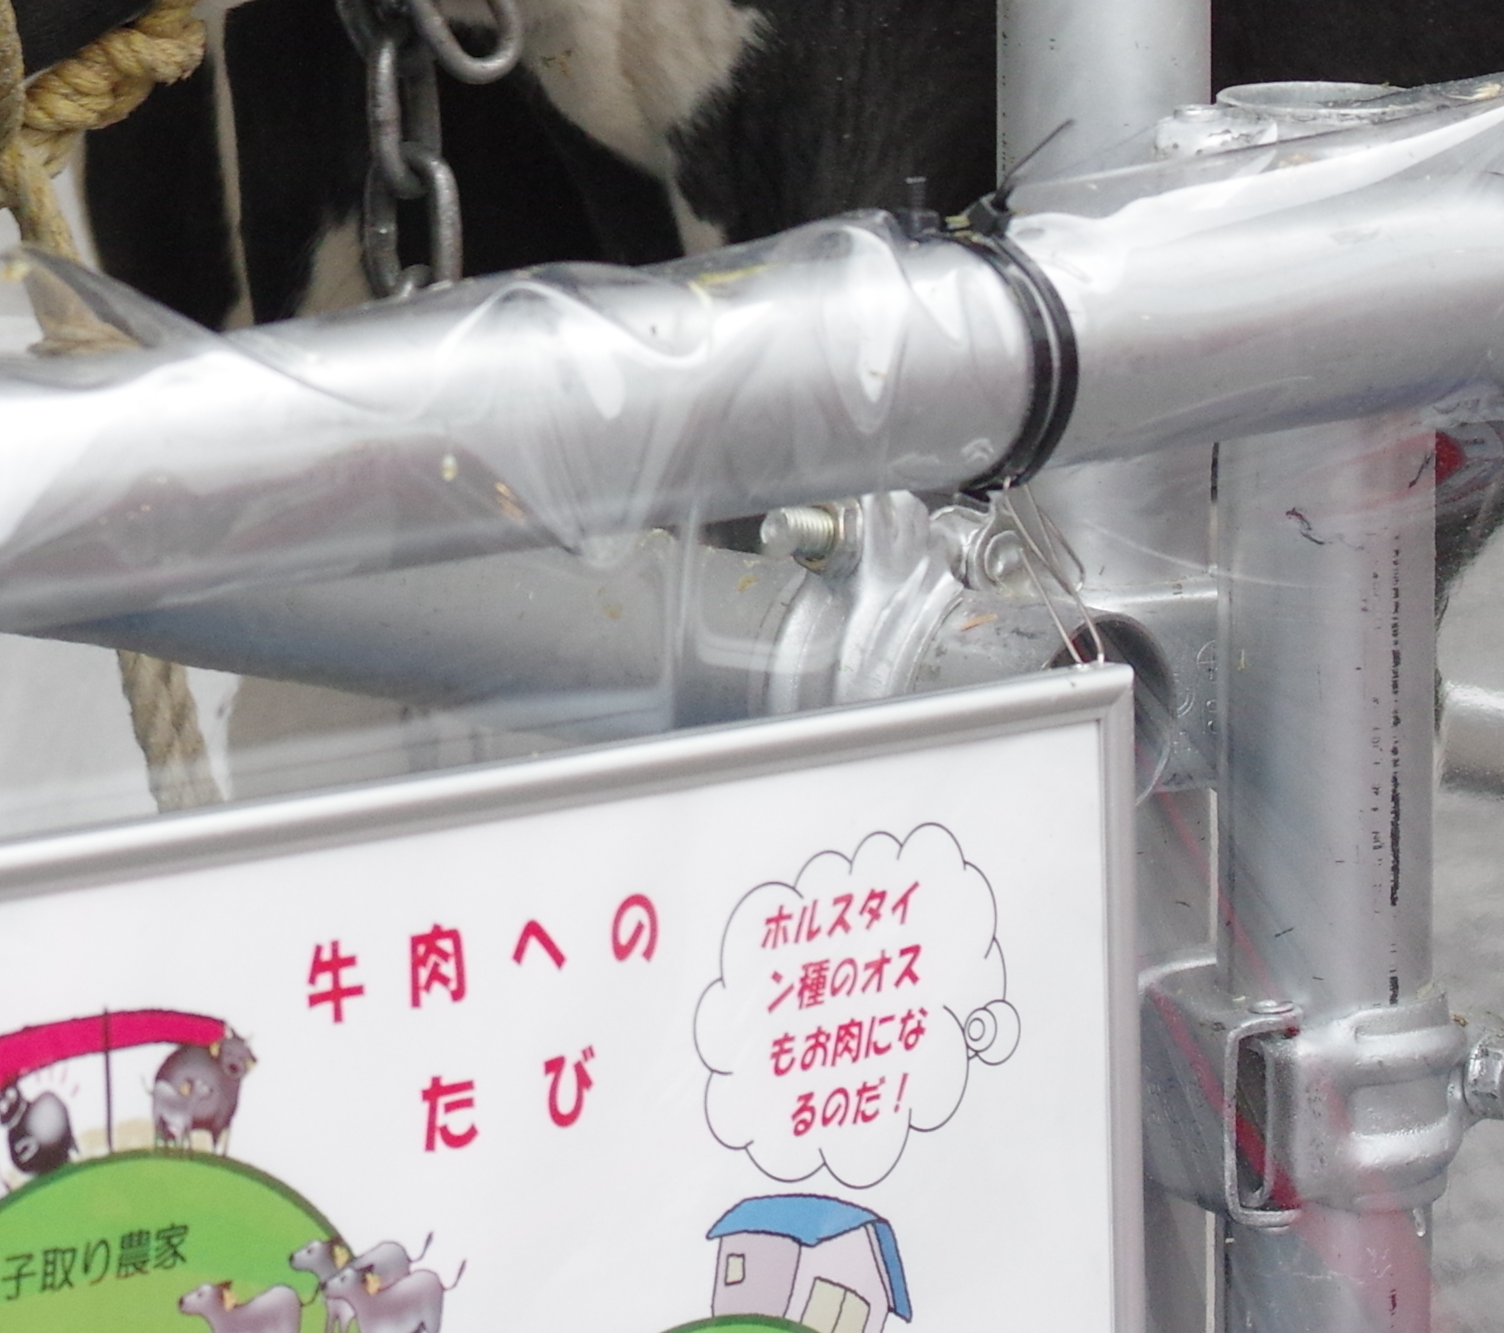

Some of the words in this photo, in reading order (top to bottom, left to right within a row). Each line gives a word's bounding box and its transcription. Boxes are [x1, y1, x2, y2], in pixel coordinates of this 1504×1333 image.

[761, 881, 920, 949] ホルスタイ
[307, 893, 659, 1024] 牛肉への
[767, 944, 922, 1013] ン種のオス
[770, 1007, 929, 1077] もお肉にな
[421, 1045, 596, 1152] たび
[1, 1223, 189, 1301] 子取り農家
